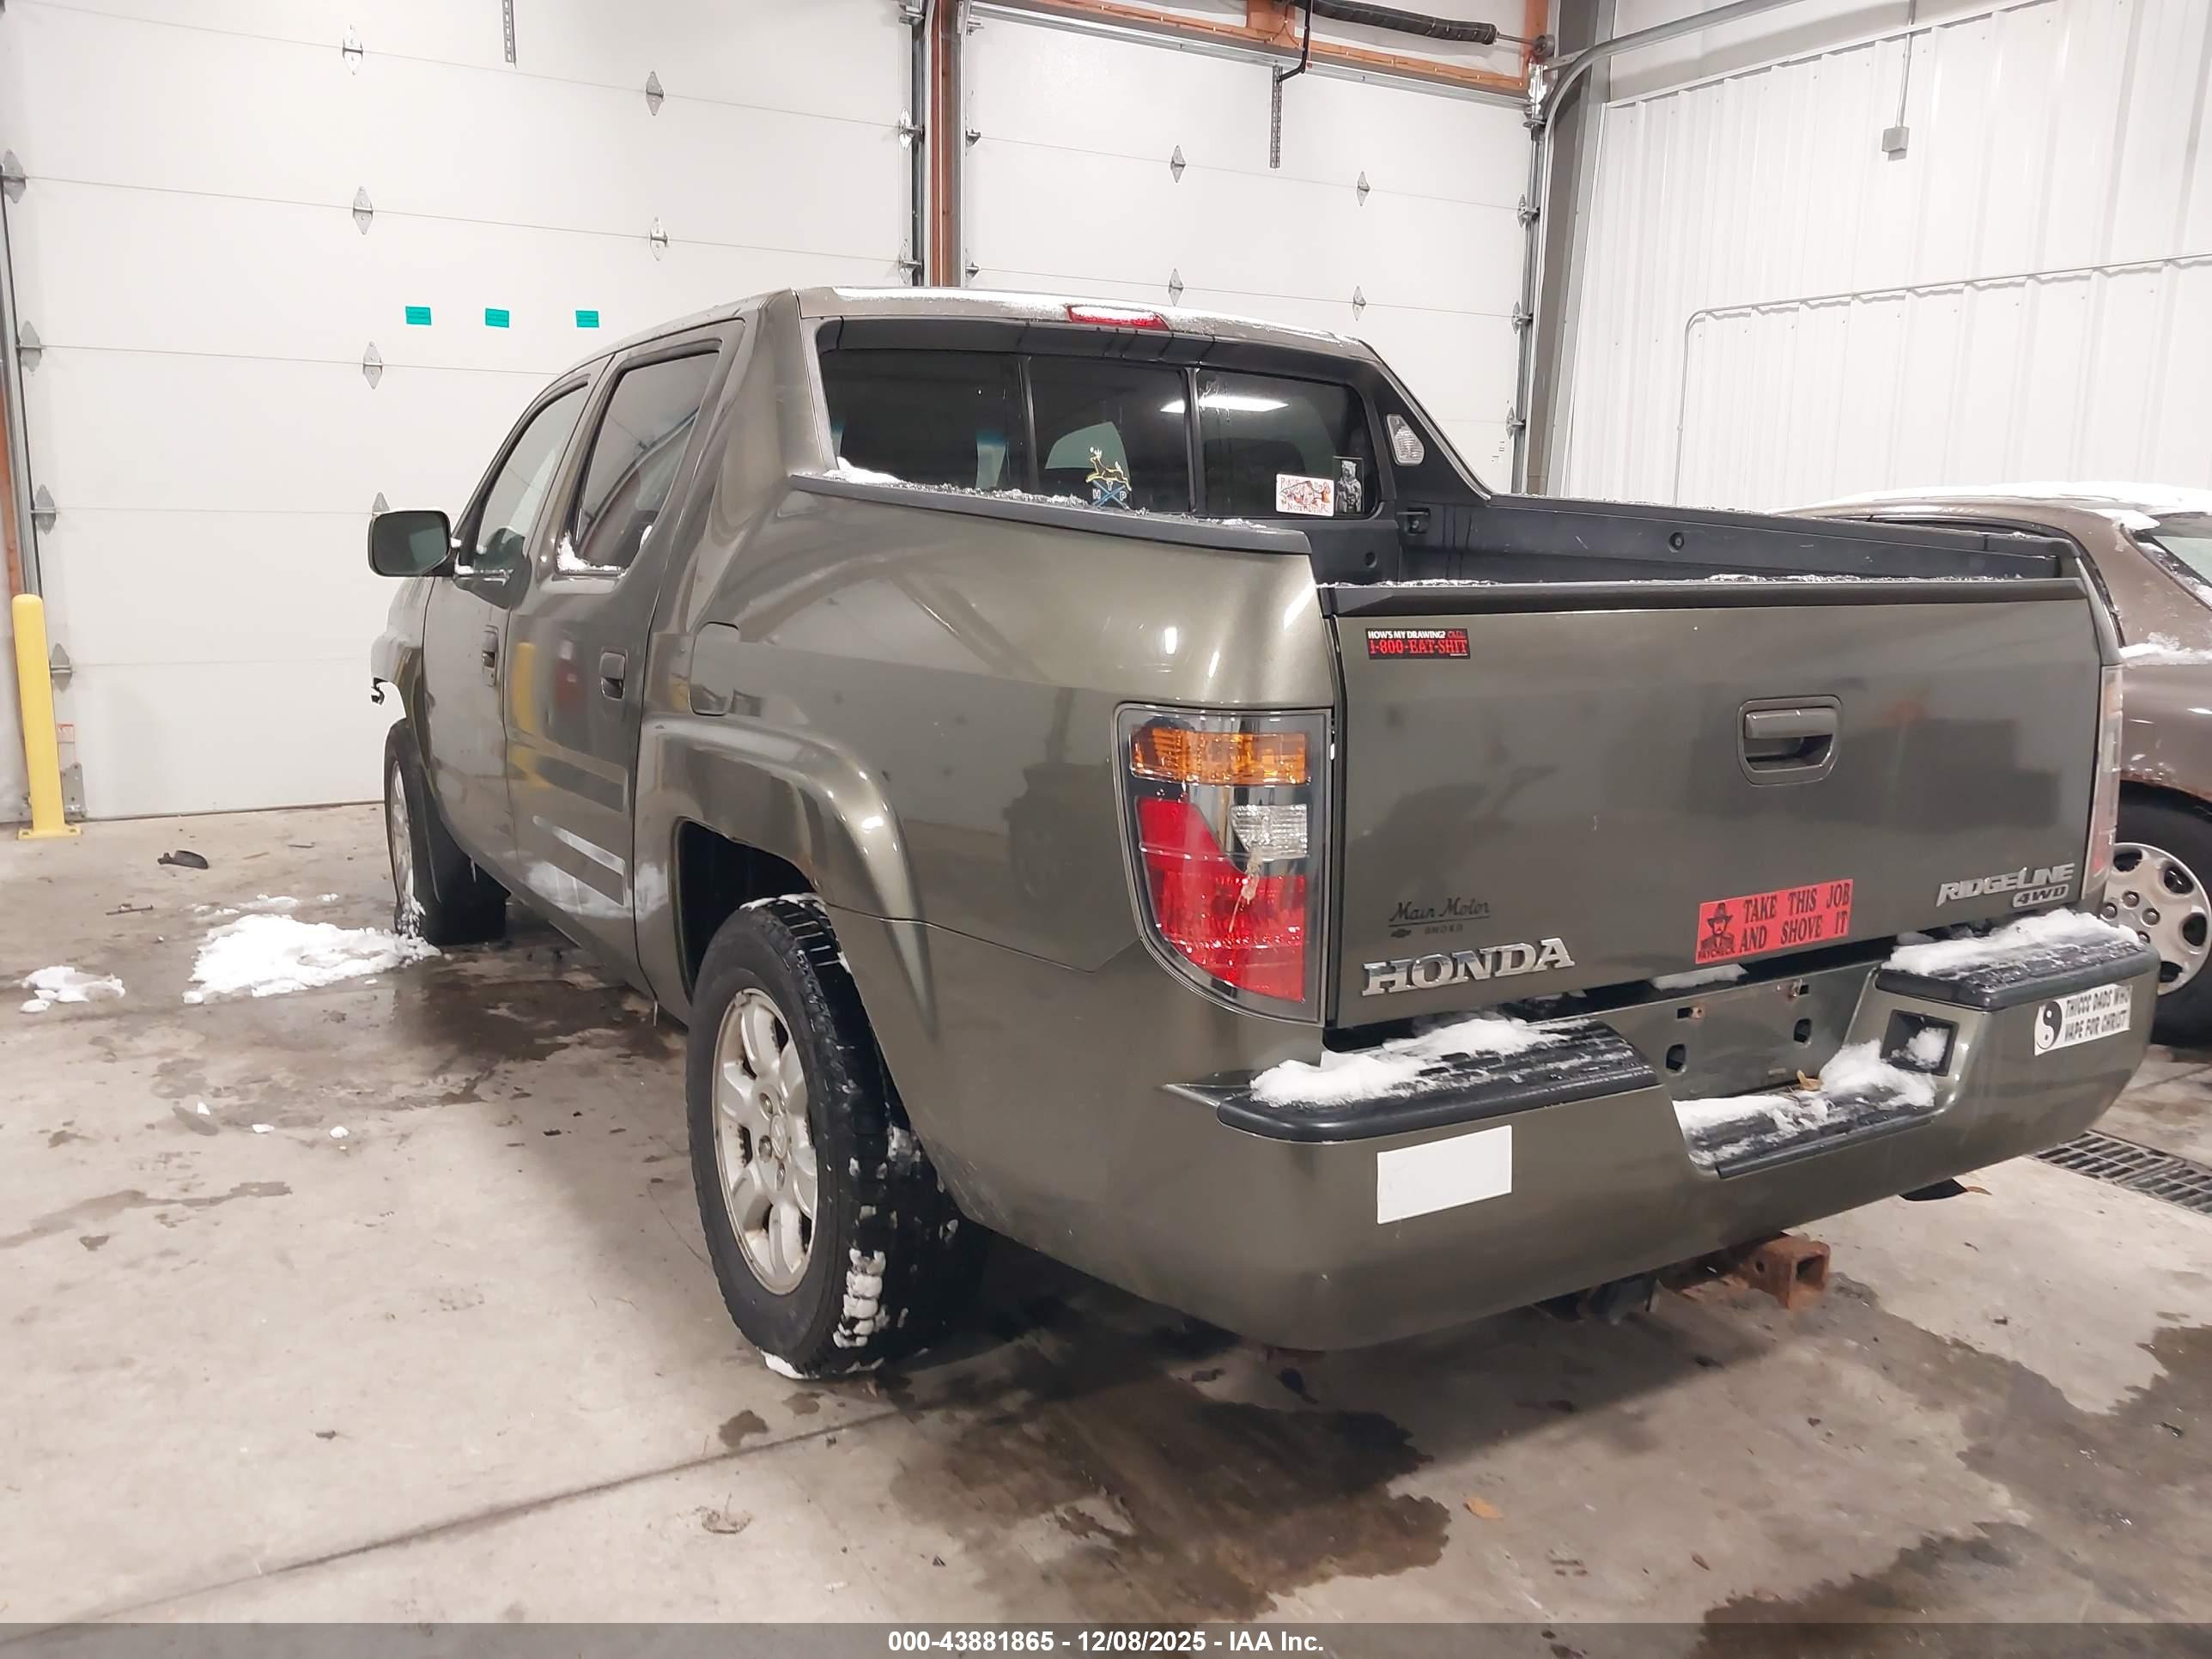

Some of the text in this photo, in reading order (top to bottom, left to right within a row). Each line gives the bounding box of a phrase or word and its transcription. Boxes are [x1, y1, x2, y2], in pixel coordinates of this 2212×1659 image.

[1370, 639, 1468, 654] 1-800-EAT-SHIT
[1394, 630, 1407, 639] MY
[1936, 863, 2075, 908] RIDGELINE
[2018, 886, 2066, 904] 4WD
[1389, 901, 1436, 921] Main
[1744, 882, 1850, 924] TAKE THIS JOB
[1739, 910, 1849, 953] AND SHOVE IT
[1362, 937, 1576, 996] HONDA
